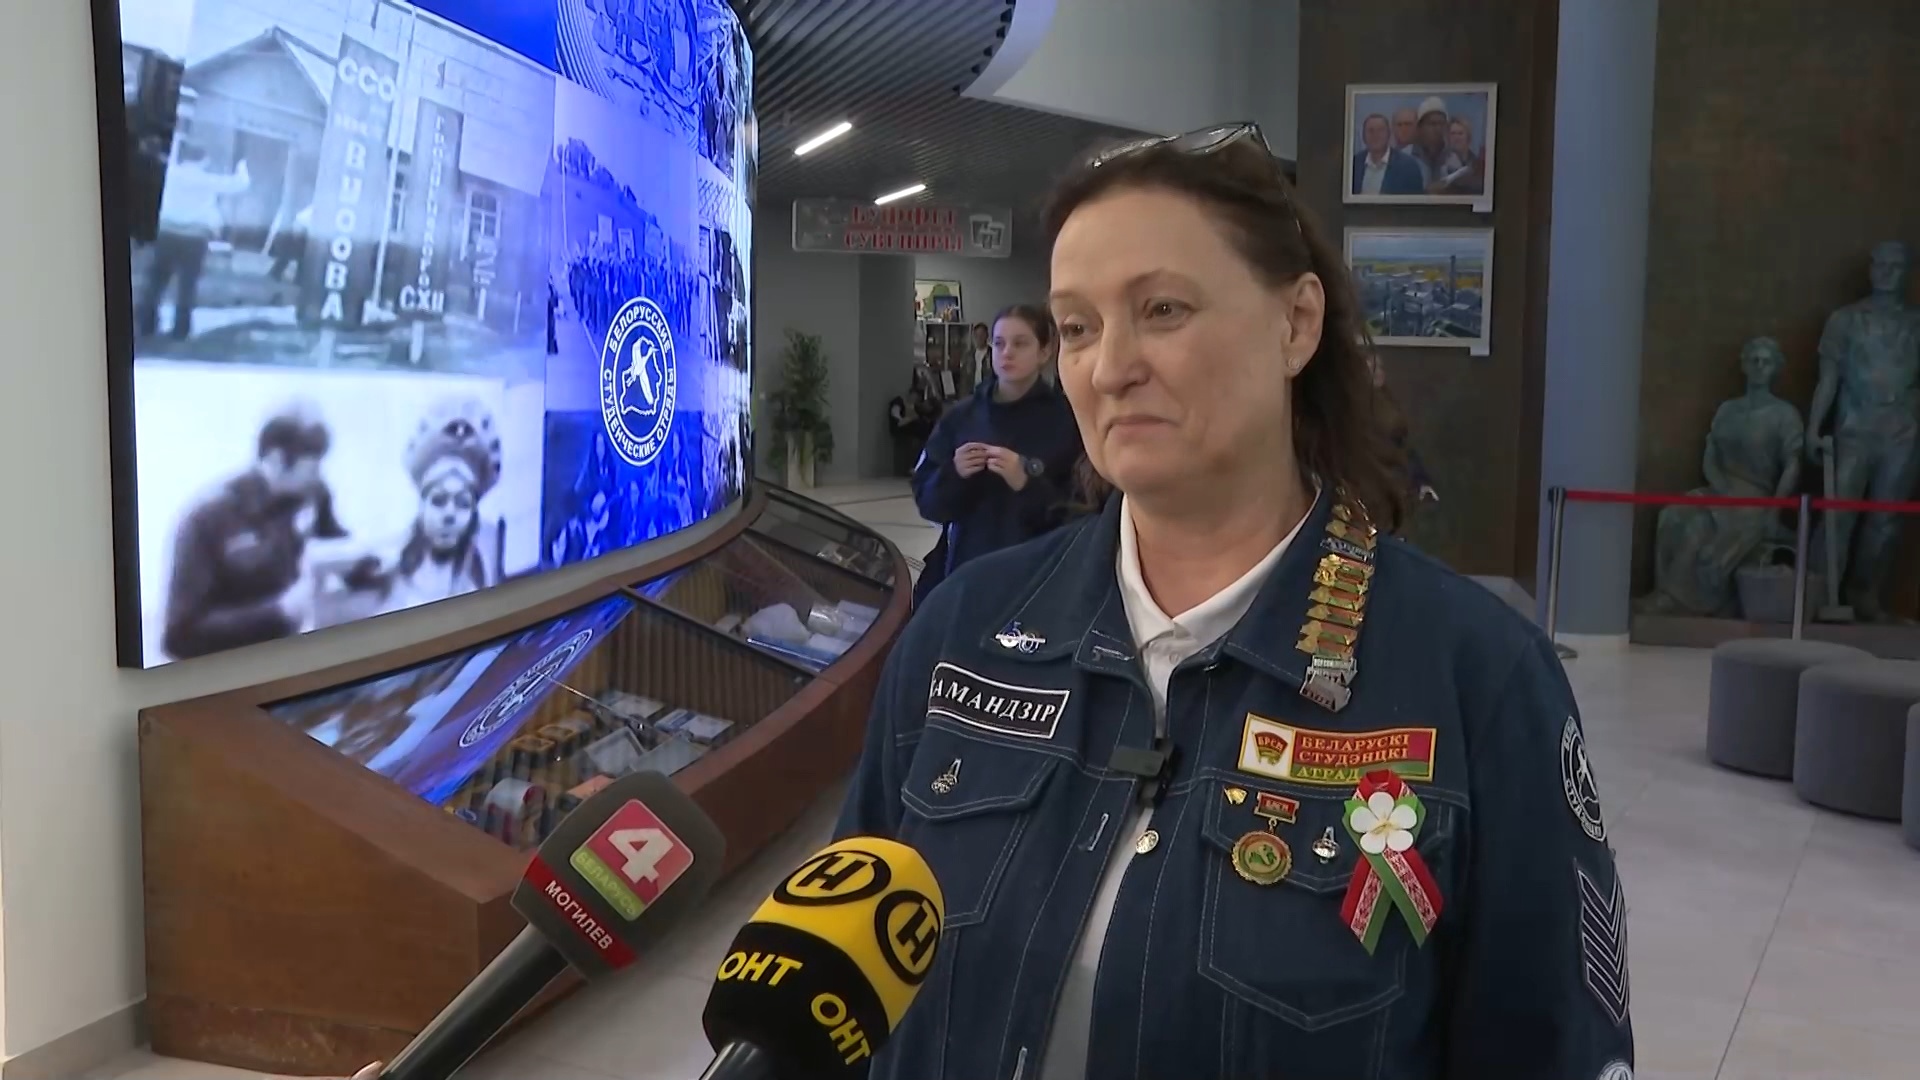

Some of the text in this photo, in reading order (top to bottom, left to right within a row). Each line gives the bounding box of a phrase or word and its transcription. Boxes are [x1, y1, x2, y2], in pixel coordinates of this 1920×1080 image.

[844, 231, 964, 252] СУВЕНИРЫ
[608, 305, 672, 354] БЕЛОРУССКИЕ
[603, 368, 675, 459] СТУДЕНЧЕСКИЕ ОТРЯДЫ
[929, 678, 1056, 722] АМАНДЗІР
[1299, 748, 1409, 768] СТУДЭНЦКІ
[1301, 734, 1410, 752] БЕЛАРУСКІ
[607, 827, 674, 884] 4
[545, 879, 613, 950] МОГИЛЕВ
[717, 951, 804, 987] ОНТ
[810, 992, 872, 1066] ОНТ
